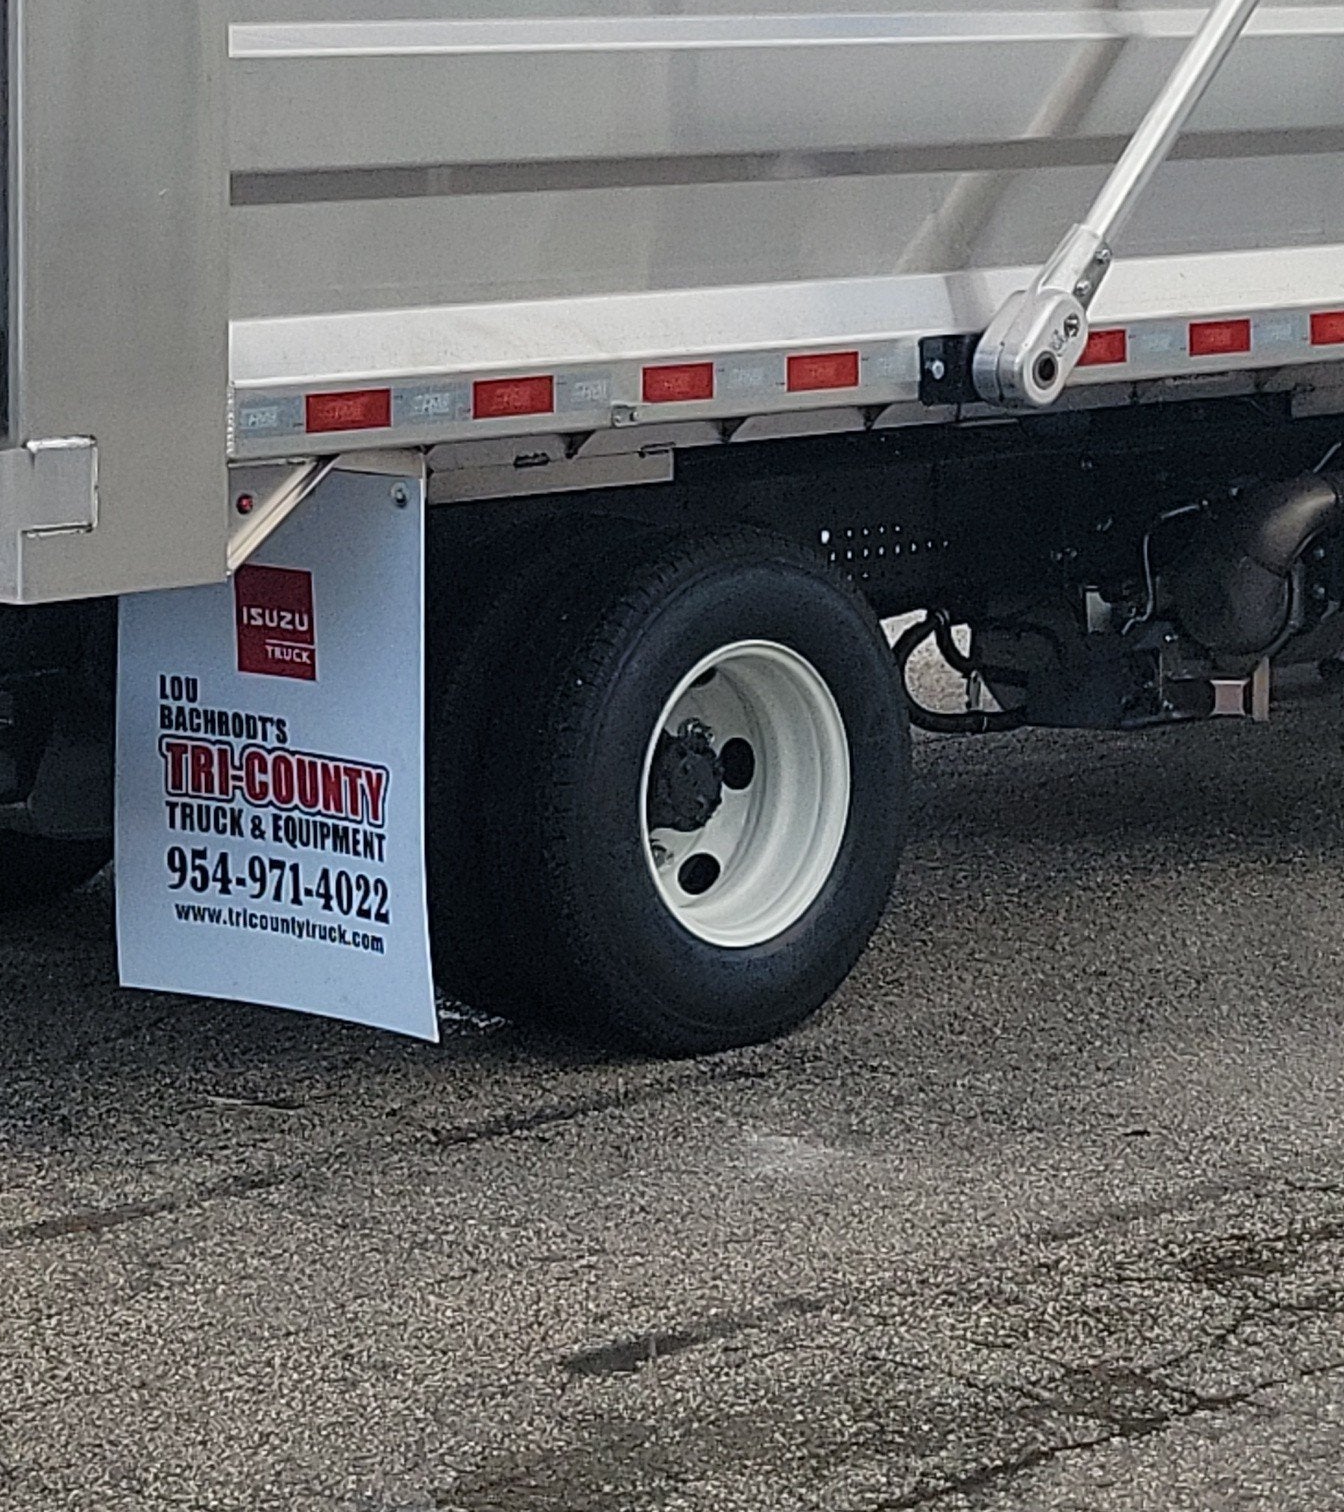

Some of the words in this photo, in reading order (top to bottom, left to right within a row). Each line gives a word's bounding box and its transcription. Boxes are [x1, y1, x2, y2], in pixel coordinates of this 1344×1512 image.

[241, 606, 309, 632] ISUZU
[264, 644, 312, 665] TRUCK
[158, 674, 199, 703] LOU
[159, 703, 288, 744] BACHRODT'S
[162, 738, 387, 824] TRI-COUNTY
[165, 800, 244, 838] TRUCK
[250, 814, 266, 840] &
[272, 813, 387, 862] EQUIPMENT
[167, 845, 390, 925] 954-971-4022
[174, 903, 385, 954] www.tricountytruck.com
